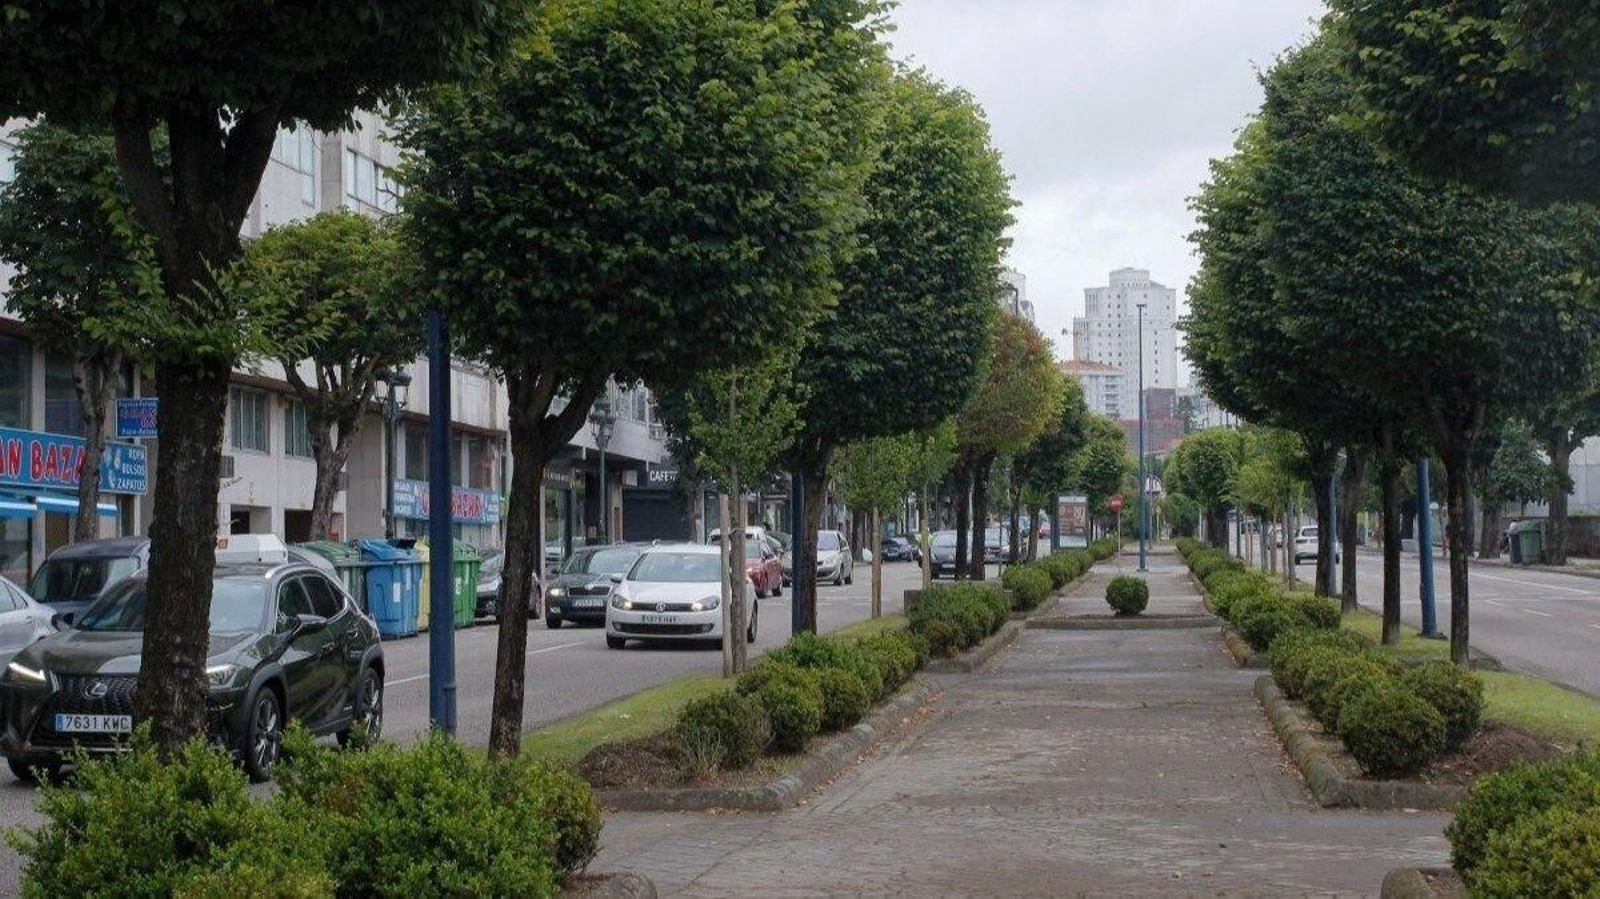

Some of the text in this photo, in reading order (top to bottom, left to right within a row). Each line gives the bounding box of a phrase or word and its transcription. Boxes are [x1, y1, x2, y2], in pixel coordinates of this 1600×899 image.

[31, 440, 87, 484] BAZA
[121, 462, 145, 476] BOLSOS
[117, 478, 146, 491] ZAPATOS
[65, 715, 97, 729] 7631
